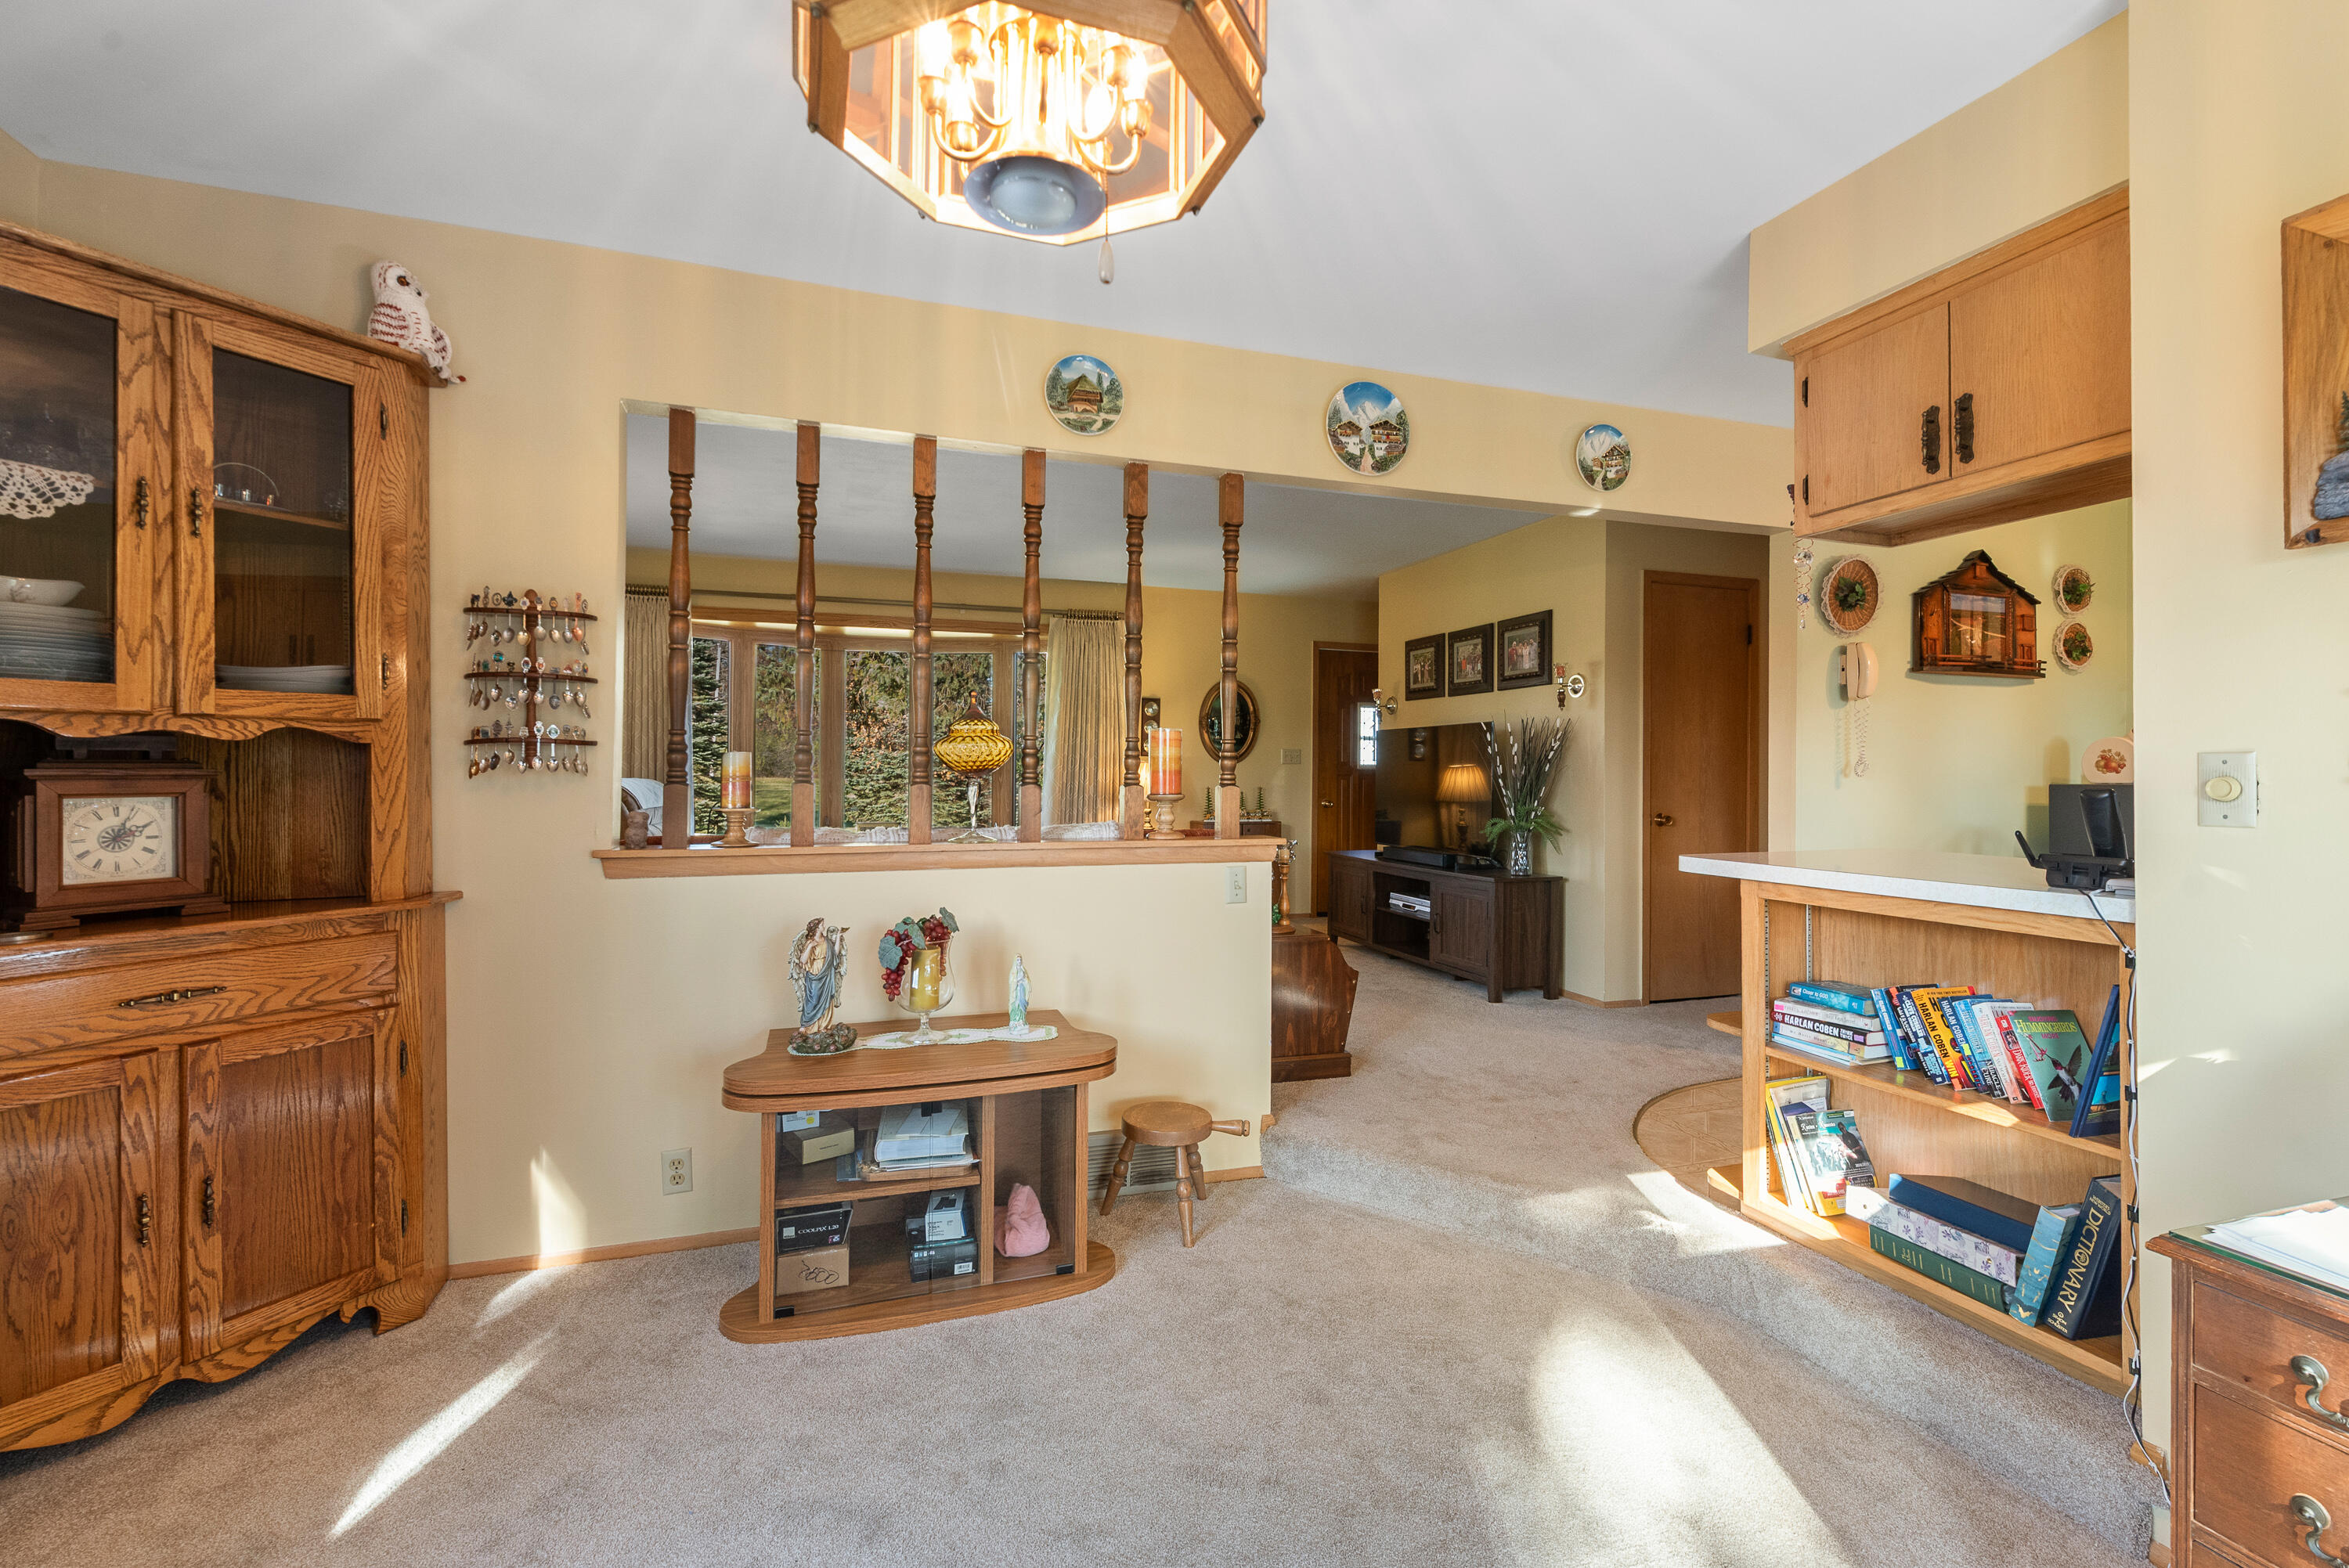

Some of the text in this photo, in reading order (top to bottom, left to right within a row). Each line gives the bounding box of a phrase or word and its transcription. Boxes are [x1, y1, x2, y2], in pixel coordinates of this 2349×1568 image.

[1941, 1000, 1957, 1026] HARLAN
[1784, 1015, 1813, 1030] HARLAN
[1813, 1022, 1841, 1037] COBEN
[2014, 1020, 2077, 1033] HUMMINGBIRDS
[1919, 1002, 1938, 1032] HARLAN
[1933, 1034, 1950, 1058] COBEN
[1945, 1059, 1959, 1078] WIN
[1982, 1067, 1994, 1086] CURE
[1986, 1059, 2001, 1089] MIRACLE
[798, 1226, 827, 1235] COOLPIX
[2058, 1207, 2105, 1314] DICTIONARY
[2048, 1317, 2069, 1334] SCHUSTER
[2052, 1313, 2068, 1326] SIMON
